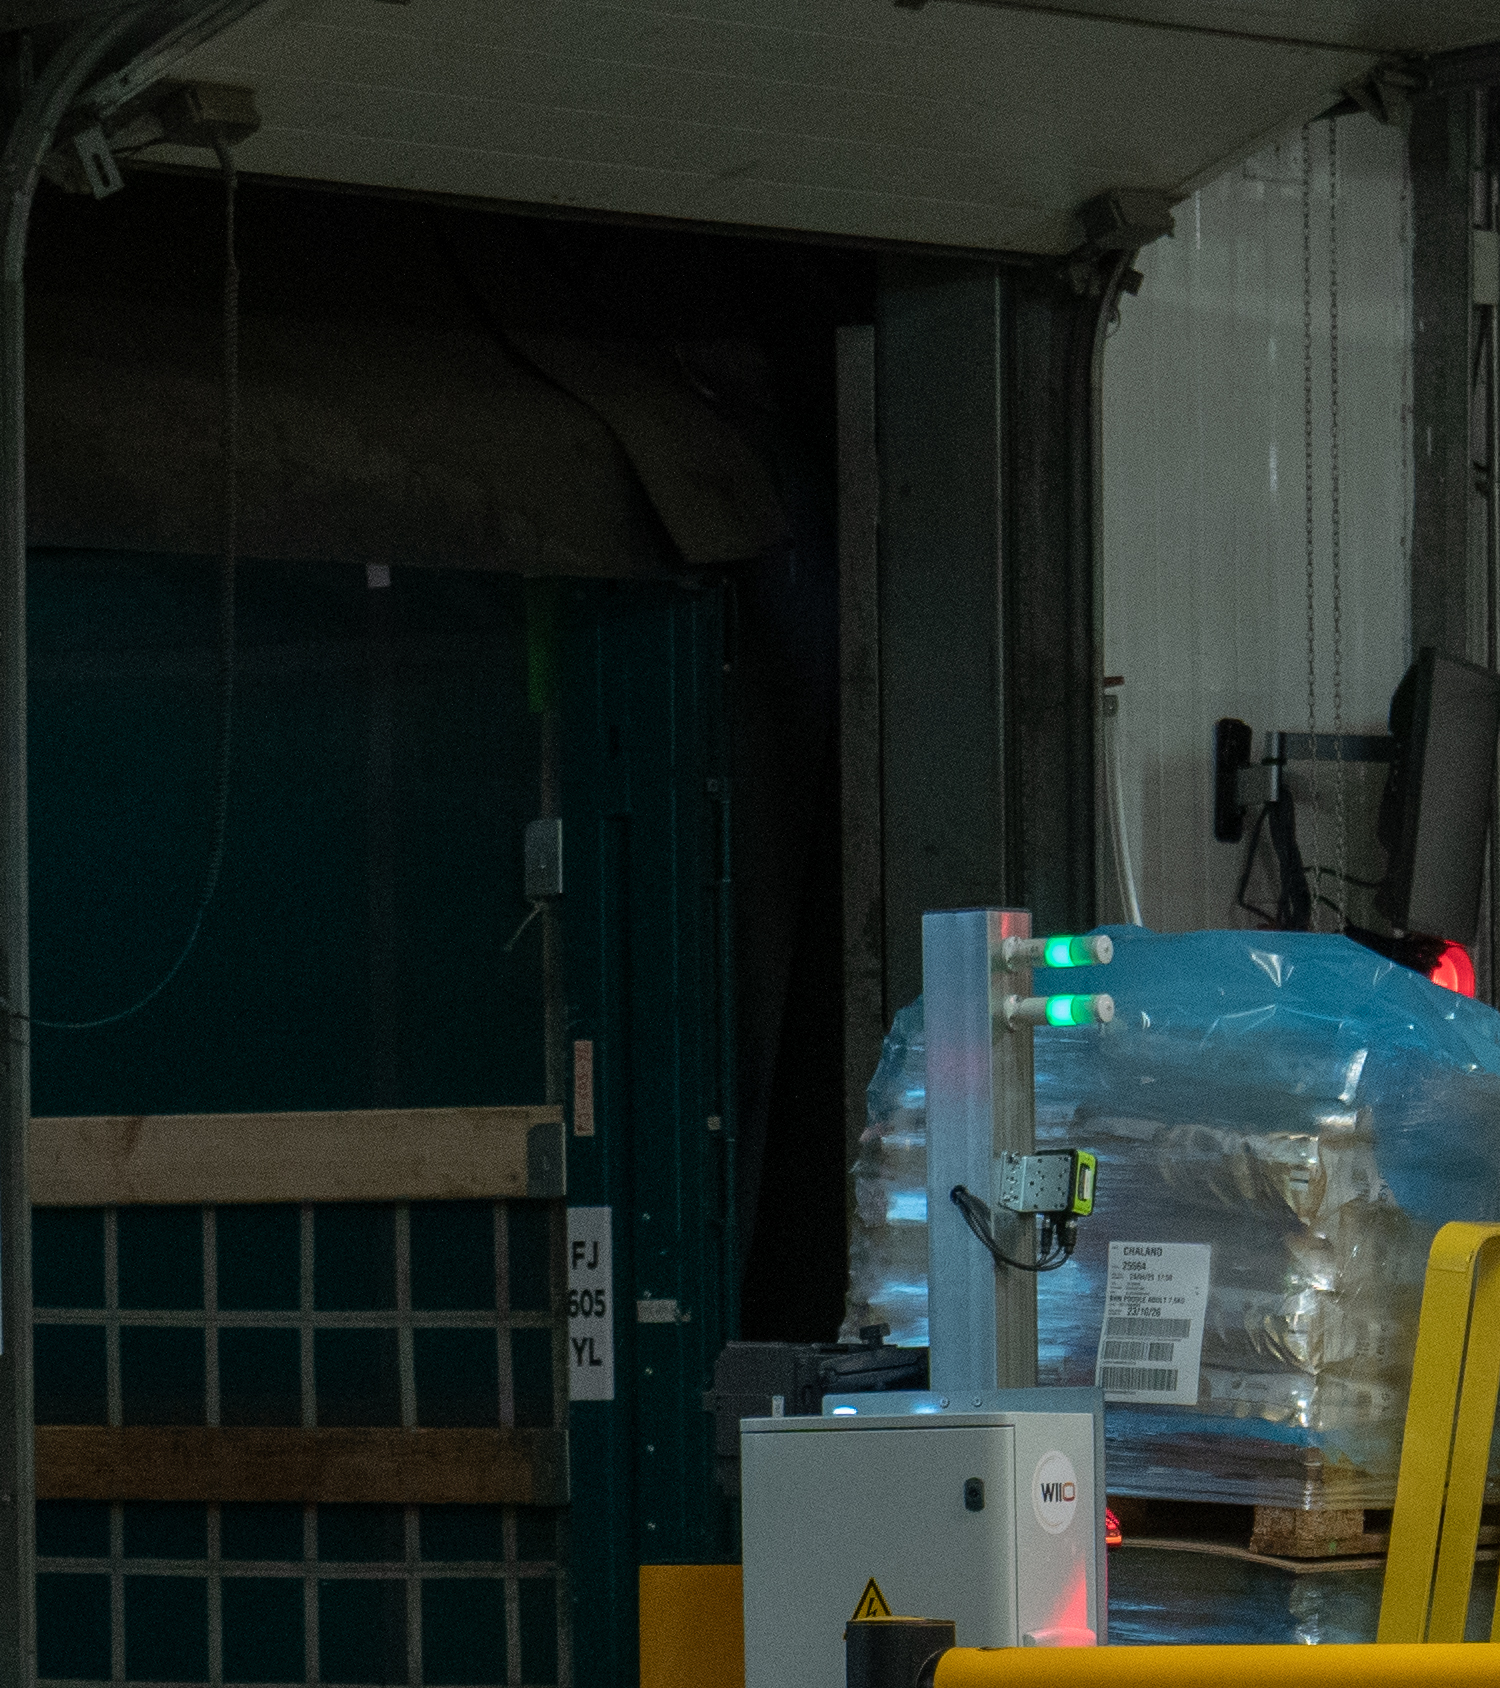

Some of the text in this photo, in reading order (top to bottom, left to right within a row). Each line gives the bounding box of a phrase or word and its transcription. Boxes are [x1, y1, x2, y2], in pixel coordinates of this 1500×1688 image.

[571, 1240, 599, 1270] FJ
[567, 1289, 606, 1318] 605
[571, 1338, 603, 1367] YL
